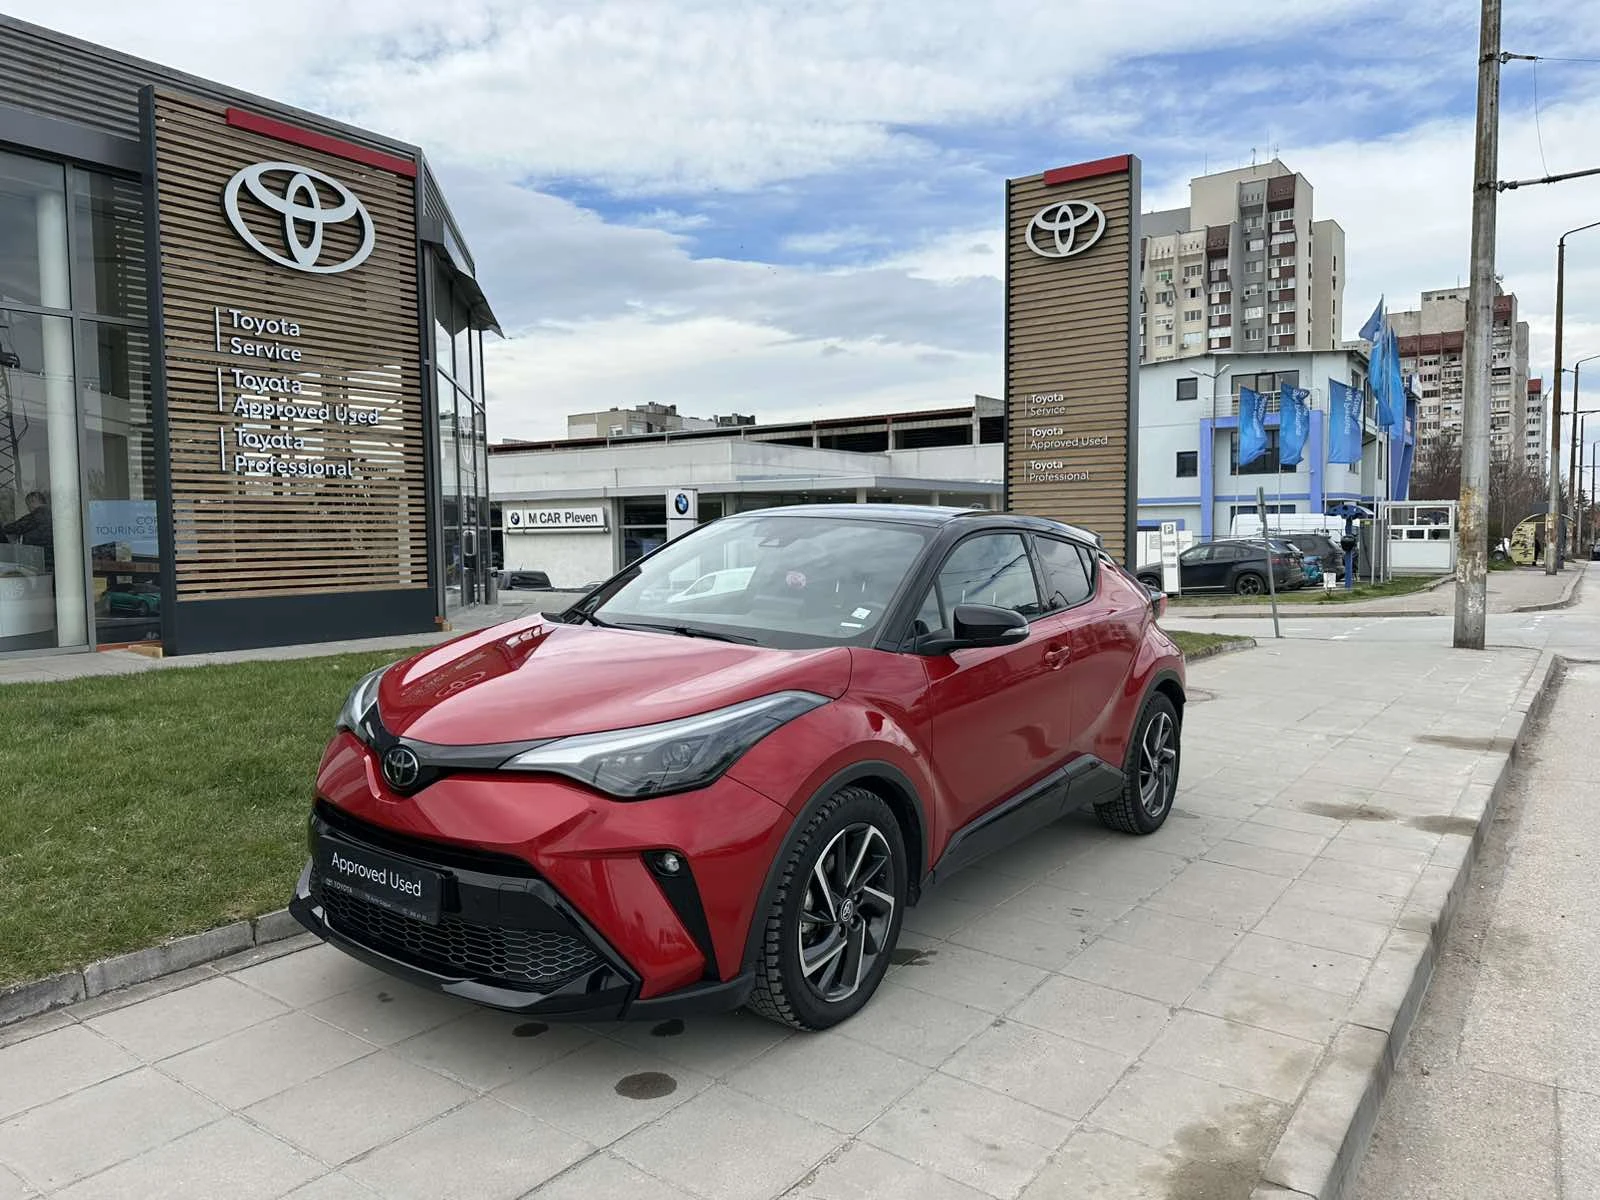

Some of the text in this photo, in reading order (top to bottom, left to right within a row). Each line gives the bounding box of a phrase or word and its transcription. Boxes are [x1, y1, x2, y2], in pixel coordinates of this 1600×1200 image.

[228, 308, 300, 336] Toyota
[230, 336, 302, 362] Service
[231, 368, 303, 395] Toyota
[1031, 392, 1064, 405] Toyota
[233, 396, 380, 425] Approved Used
[1030, 405, 1066, 416] Service
[234, 427, 305, 452] Toyota
[1031, 427, 1064, 439] Toyota
[1030, 435, 1108, 451] Approved Used
[235, 455, 353, 476] Professional
[1030, 460, 1063, 472] Toyota
[1029, 470, 1089, 482] Professional
[528, 511, 598, 524] M CAR Pleven
[96, 526, 146, 536] TOURING
[331, 852, 422, 897] Approved Used
